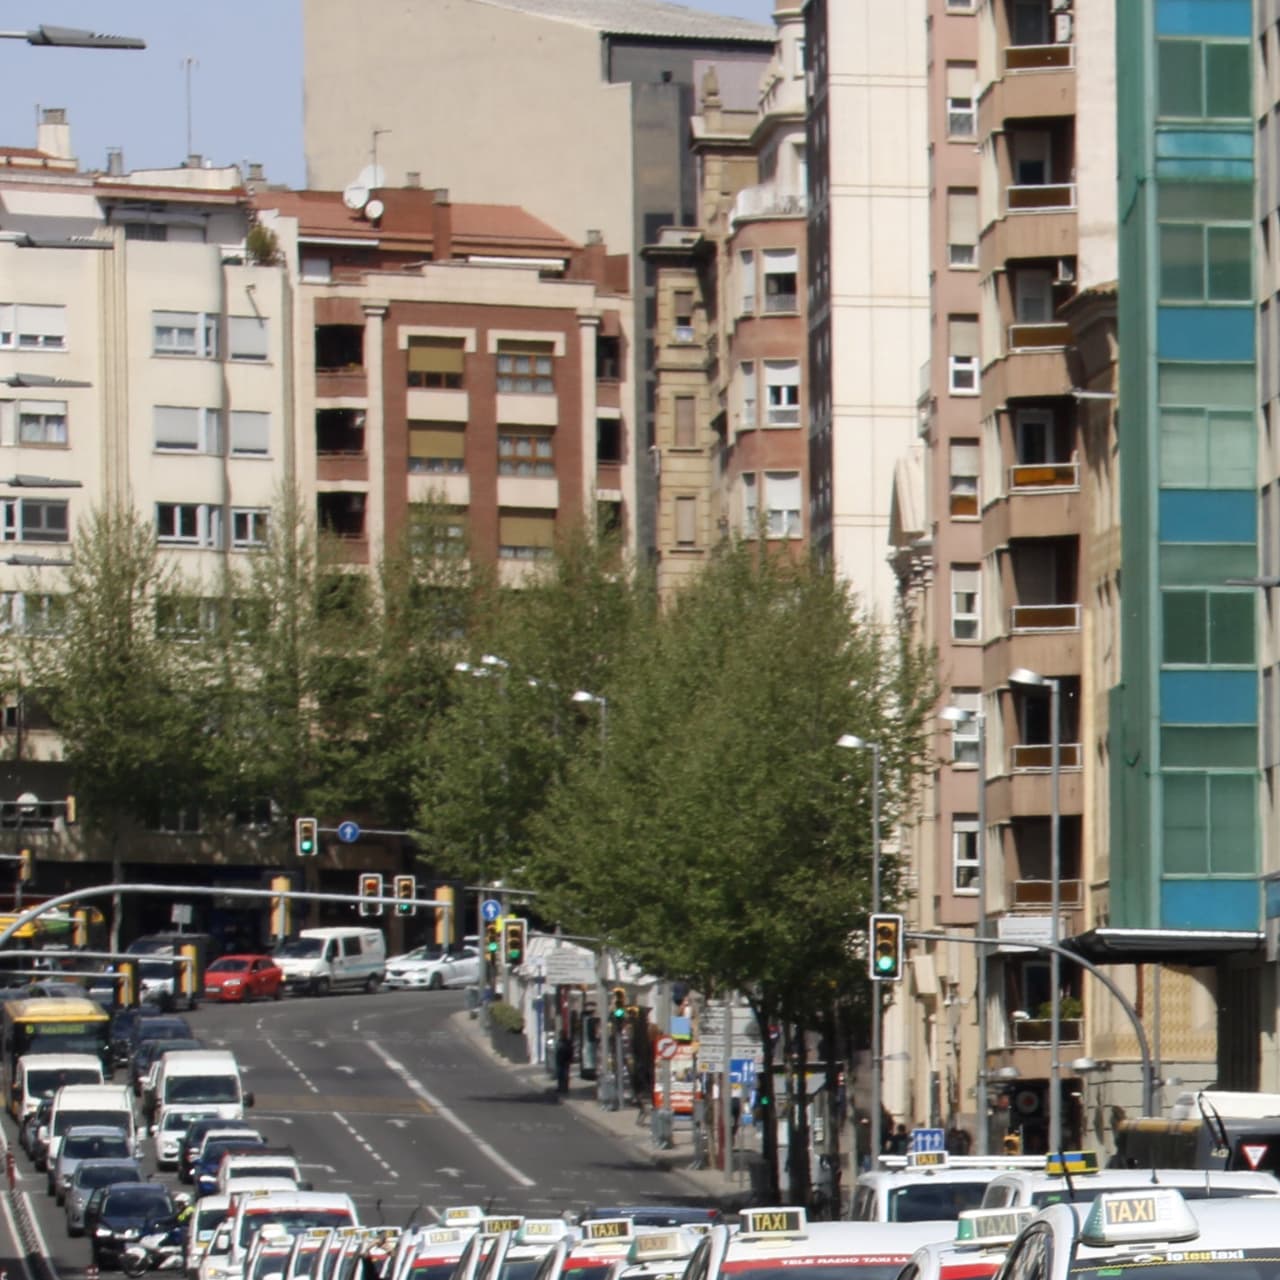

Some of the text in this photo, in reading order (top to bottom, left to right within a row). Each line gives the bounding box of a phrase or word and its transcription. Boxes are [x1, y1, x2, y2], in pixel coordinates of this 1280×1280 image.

[1107, 1199, 1155, 1222] TAXI
[753, 1213, 787, 1231] TAXI
[592, 1223, 619, 1238] TAXI
[817, 1257, 859, 1265] RADIO
[861, 1256, 891, 1264] TAXI
